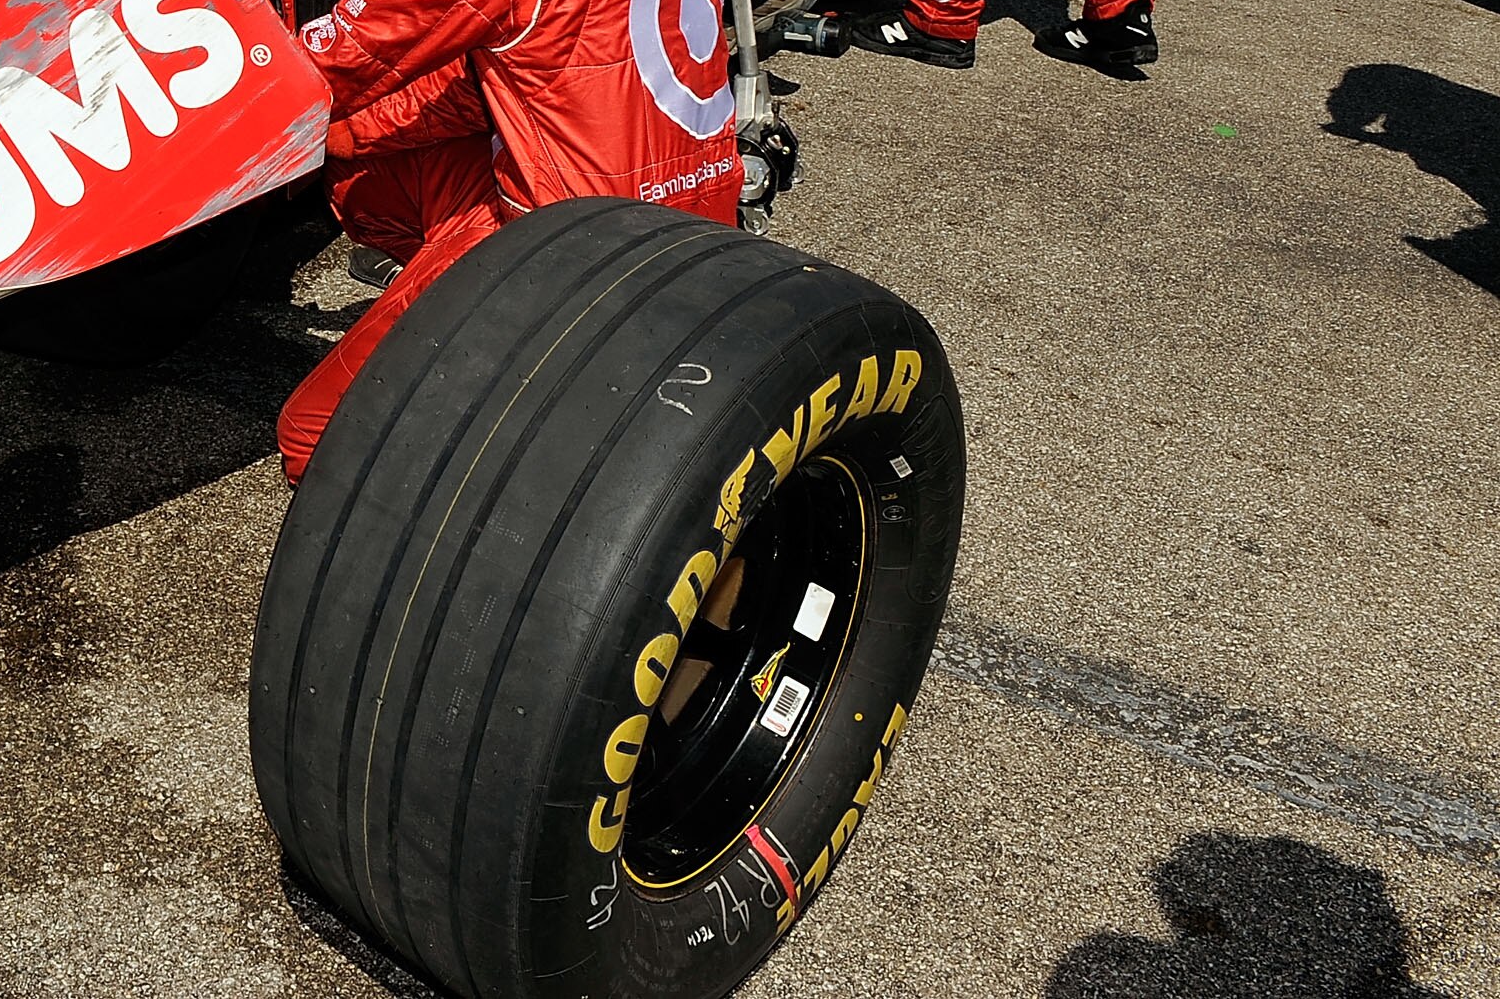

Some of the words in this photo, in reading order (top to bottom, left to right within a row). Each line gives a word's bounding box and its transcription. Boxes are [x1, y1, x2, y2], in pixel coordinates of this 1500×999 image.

[881, 2, 908, 23] N
[589, 350, 922, 853] GOODYEAR
[687, 924, 715, 947] TECH
